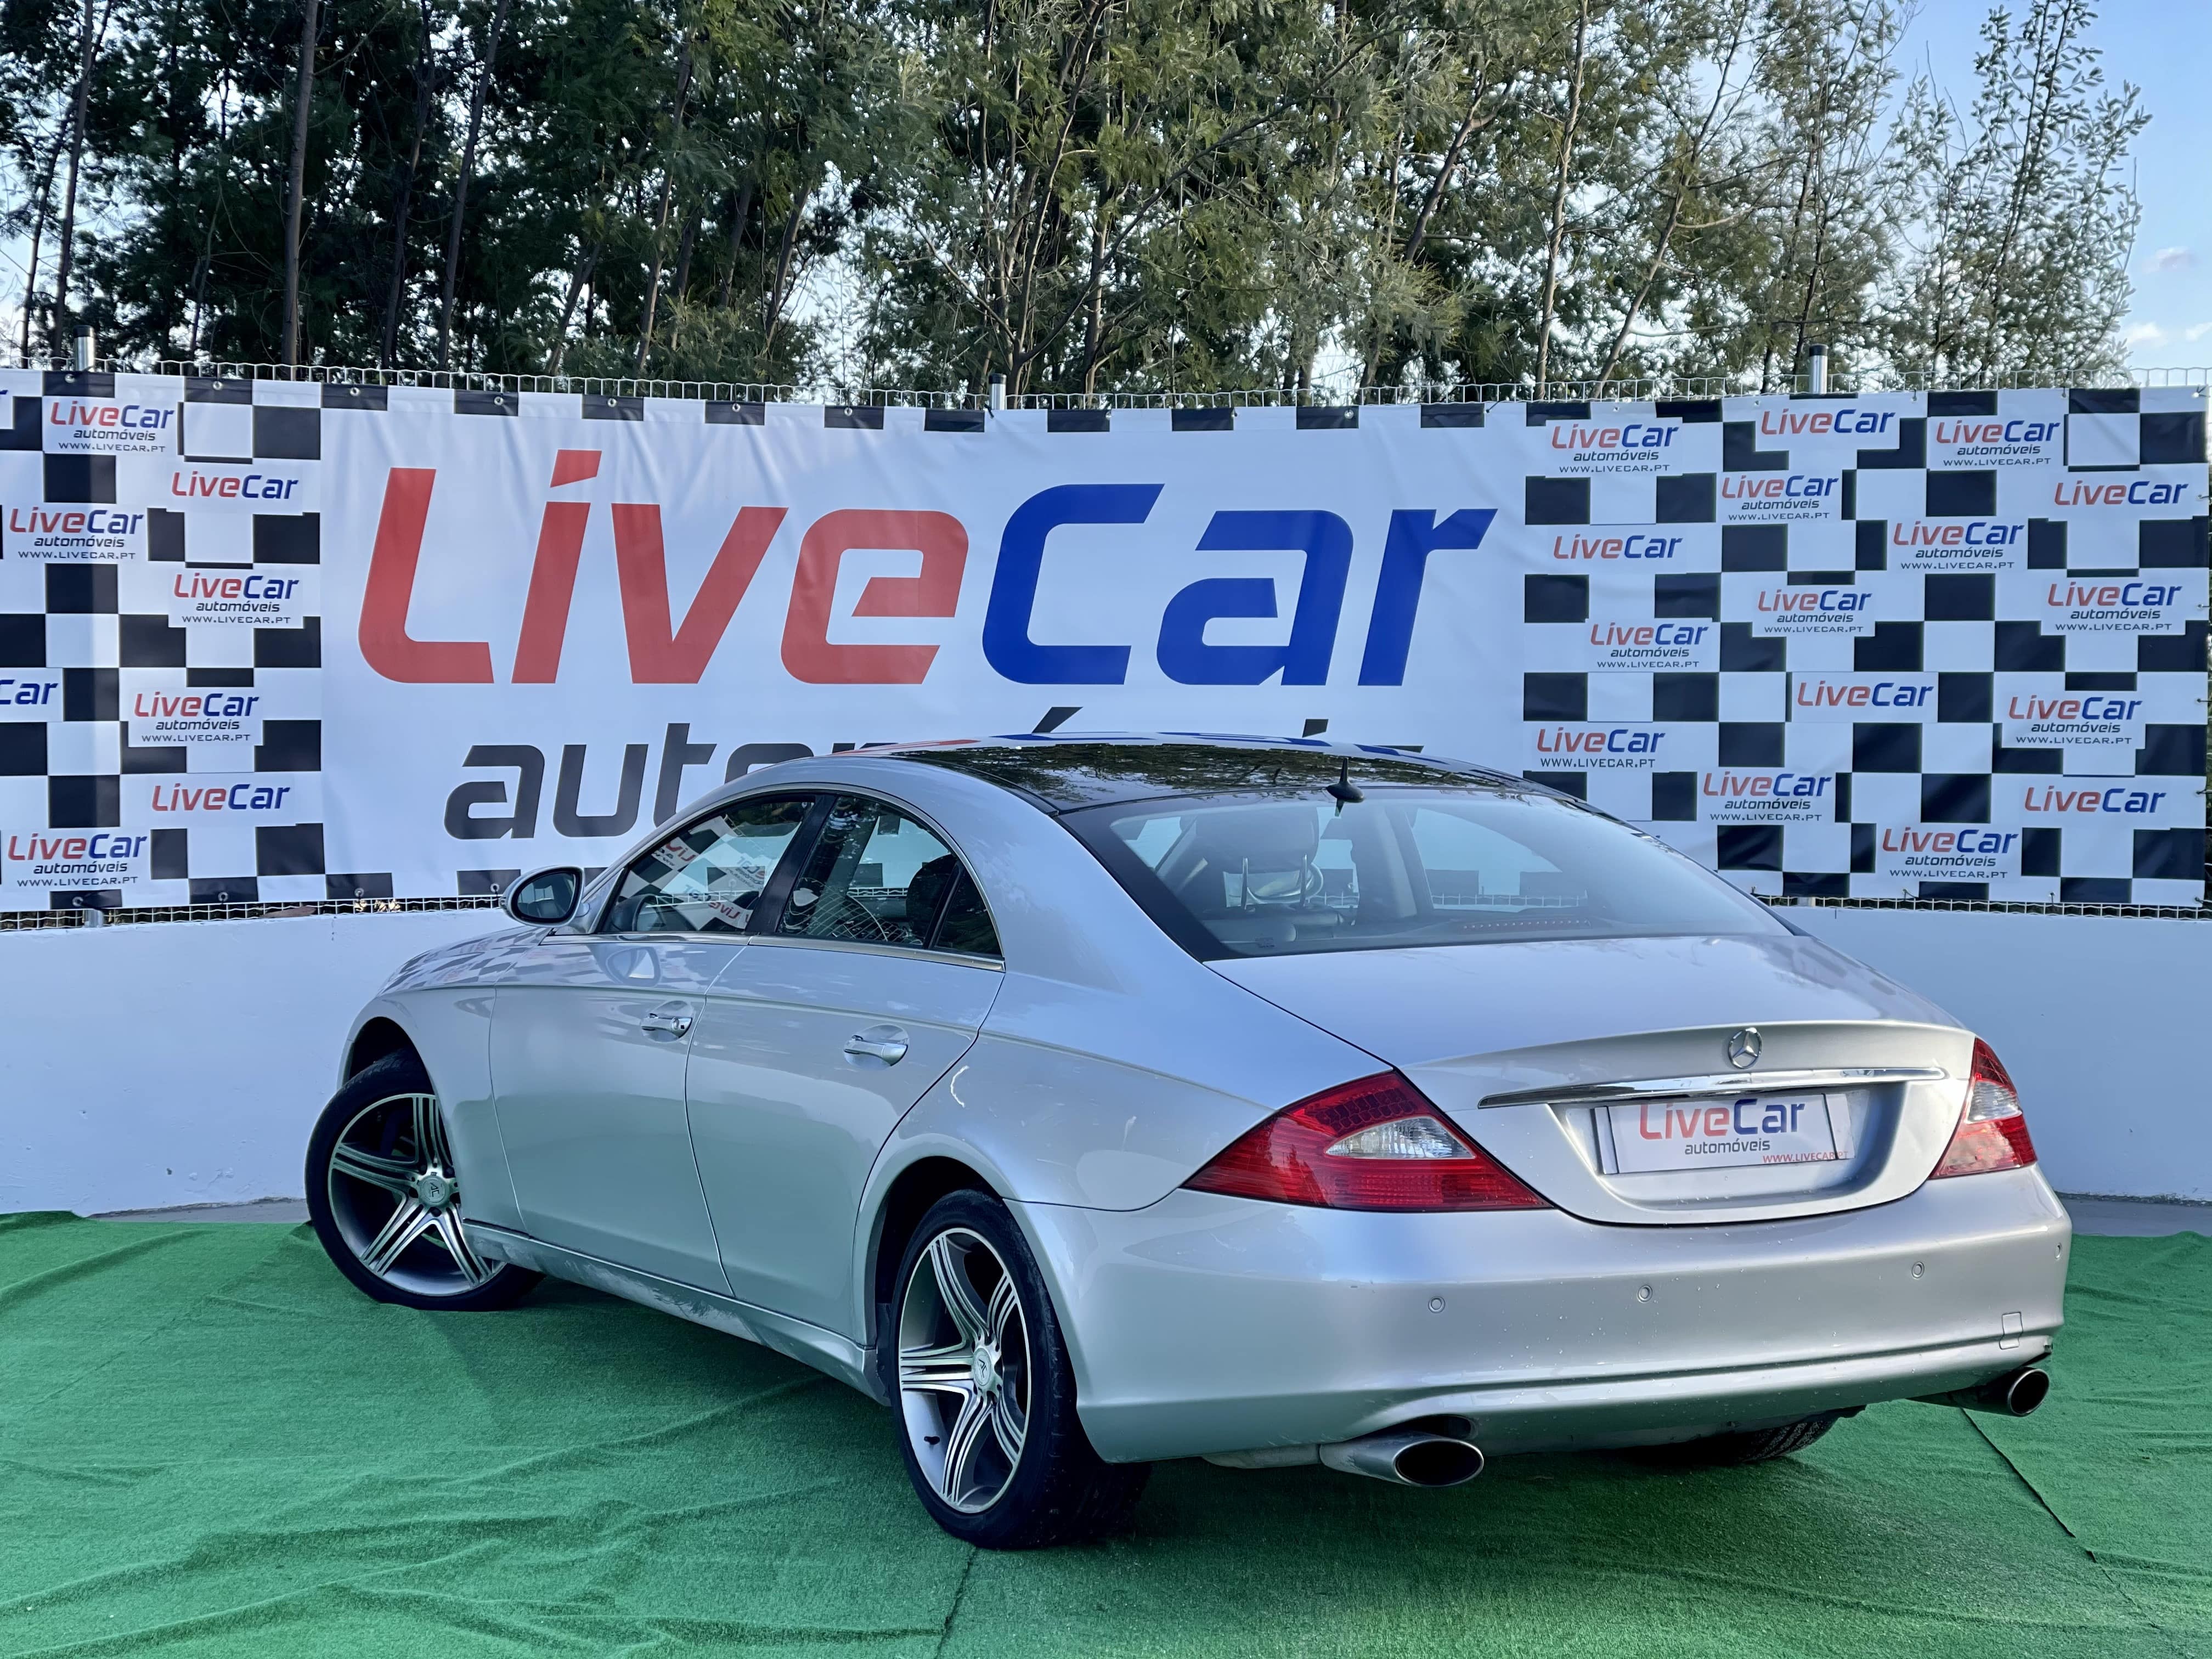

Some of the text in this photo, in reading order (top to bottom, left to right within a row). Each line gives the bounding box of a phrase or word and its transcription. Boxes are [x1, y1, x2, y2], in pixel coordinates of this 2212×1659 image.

[50, 400, 175, 429] LiveCar
[1762, 409, 1896, 435] LiveCar
[73, 428, 156, 441] automóveis
[1552, 424, 1679, 449] LiveCar
[1937, 420, 2061, 443] LiveCar
[58, 442, 166, 453] WWW.LIVECAR.PT
[1957, 443, 2041, 455] automóveis
[1573, 449, 1659, 461] automóveis
[1559, 464, 1671, 473] WWW.LIVECAR.PT
[1943, 458, 2051, 466] WWW.LIVECAR.PT
[172, 471, 299, 499] LiveCar
[1722, 475, 1839, 499] LiveCar
[2055, 481, 2189, 505] LiveCar
[1741, 498, 1820, 510] automóveis
[9, 506, 144, 534] LiveCar
[1728, 512, 1830, 521] WWW.LIVECAR.PT
[1894, 521, 2025, 545] LiveCar
[33, 535, 125, 548] automóveis
[1554, 534, 1683, 558] LiveCar
[18, 551, 136, 560] WWW.LIVECAR.PT
[1915, 546, 2004, 558] automóveis
[359, 450, 1498, 686] LiveCar
[174, 572, 300, 600] LiveCar
[1758, 590, 1872, 611] LiveCar
[2048, 582, 2182, 606] LiveCar
[196, 600, 280, 612] automóveis
[1777, 612, 1854, 623] automóveis
[2070, 607, 2160, 619] automóveis
[182, 616, 291, 624] WWW.LIVECAR.PT
[1590, 622, 1709, 645] LiveCar
[1610, 646, 1689, 657] automóveis
[1798, 681, 1934, 707] LiveCar
[136, 691, 260, 717] LiveCar
[2009, 695, 2143, 720] LiveCar
[155, 718, 240, 730] automóveis
[2031, 721, 2120, 733] automóveis
[142, 734, 251, 742] WWW.LIVECAR.PT
[1537, 727, 1666, 753] LiveCar
[2016, 736, 2132, 744] WWW.LIVECAR.PT
[1540, 758, 1656, 768] WWW.LIVECAR.PT
[1703, 771, 1832, 797] LiveCar
[153, 783, 291, 811] LiveCar
[2025, 786, 2166, 813] LiveCar
[1724, 798, 1811, 810] automóveis
[1709, 813, 1822, 821] WWW.LIVECAR.PT
[8, 833, 148, 861] LiveCar
[1882, 827, 2019, 854] LiveCar
[33, 860, 128, 874] automóveis
[1905, 854, 1996, 867] automóveis
[1889, 870, 2008, 878] WWW.LIVECAR.PT
[16, 876, 138, 887] WWW.LIVECAR.PT
[1639, 1099, 1804, 1140] LiveCar
[1685, 1138, 1770, 1155] automóveis
[1763, 1151, 1849, 1164] WWW.LIVECARPT
